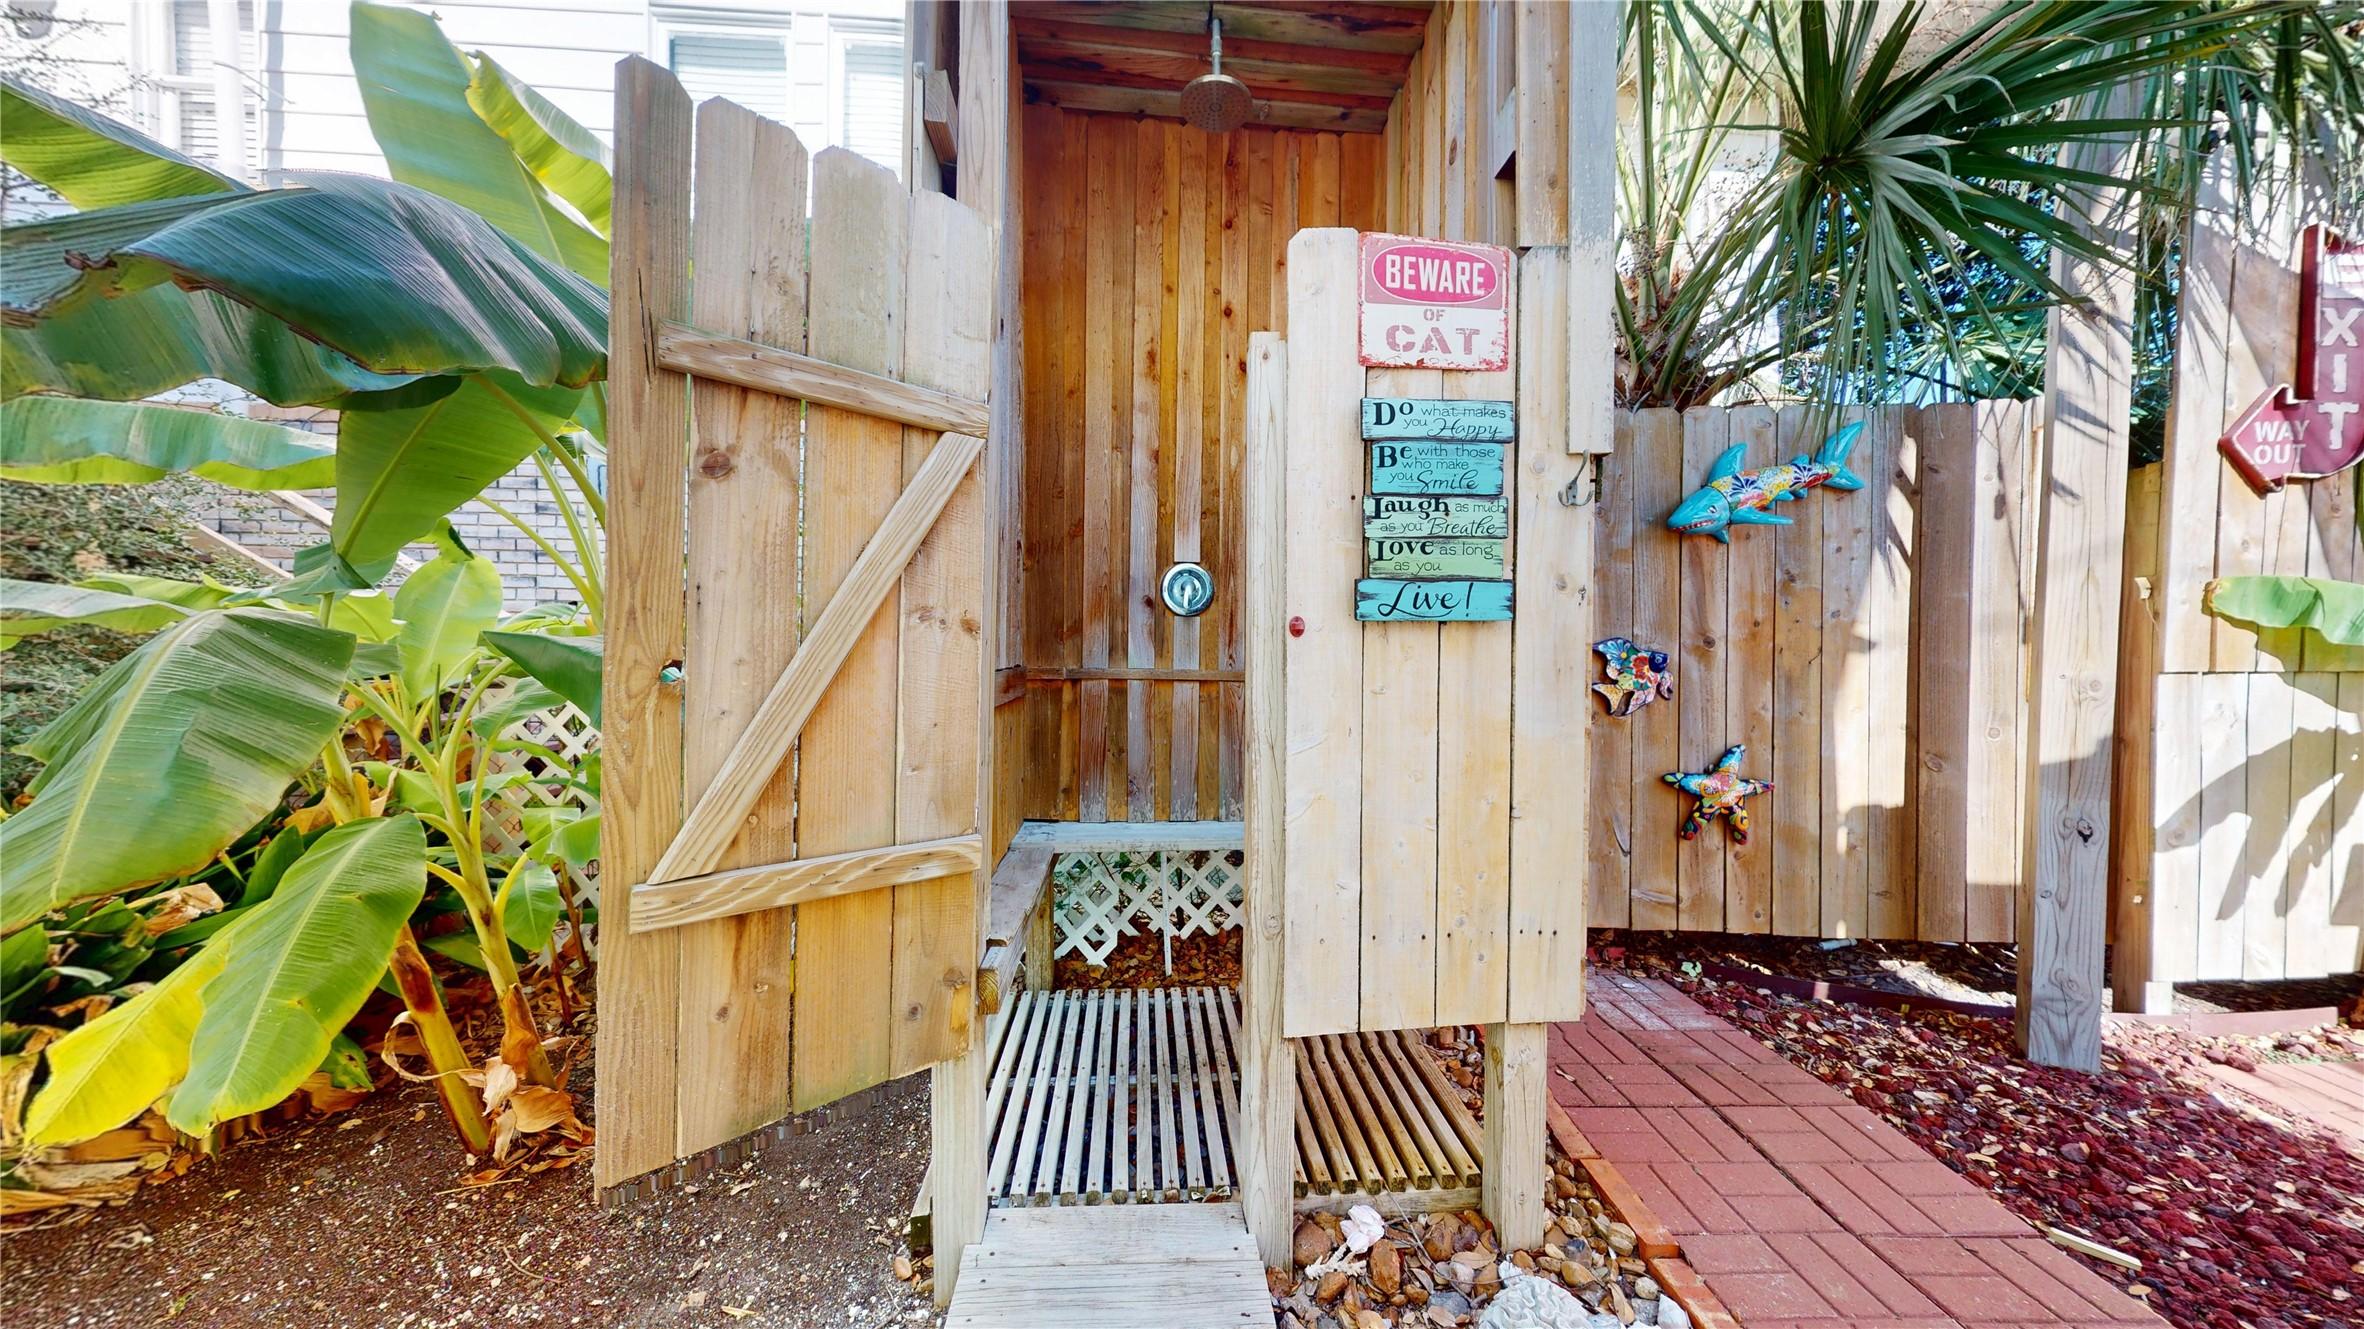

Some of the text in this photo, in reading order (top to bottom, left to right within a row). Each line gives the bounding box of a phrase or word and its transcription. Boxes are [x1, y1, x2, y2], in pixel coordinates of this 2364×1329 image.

[1385, 254, 1486, 296] BEWARE
[1423, 308, 1446, 321] OF
[1386, 324, 1480, 355] CAT
[1372, 402, 1506, 425] Do what makes
[1403, 417, 1502, 440] you Happy
[2253, 419, 2310, 443] WAY
[1376, 444, 1496, 468] Be with those
[1402, 457, 1469, 470] who make
[2253, 443, 2306, 465] OUT
[1389, 469, 1478, 493] you Smile
[1371, 497, 1505, 520] Laugh as much
[1380, 516, 1497, 536] as you Breathe
[1373, 540, 1494, 561] Love as long
[1393, 561, 1442, 575] as you
[1377, 582, 1474, 618] Live!
